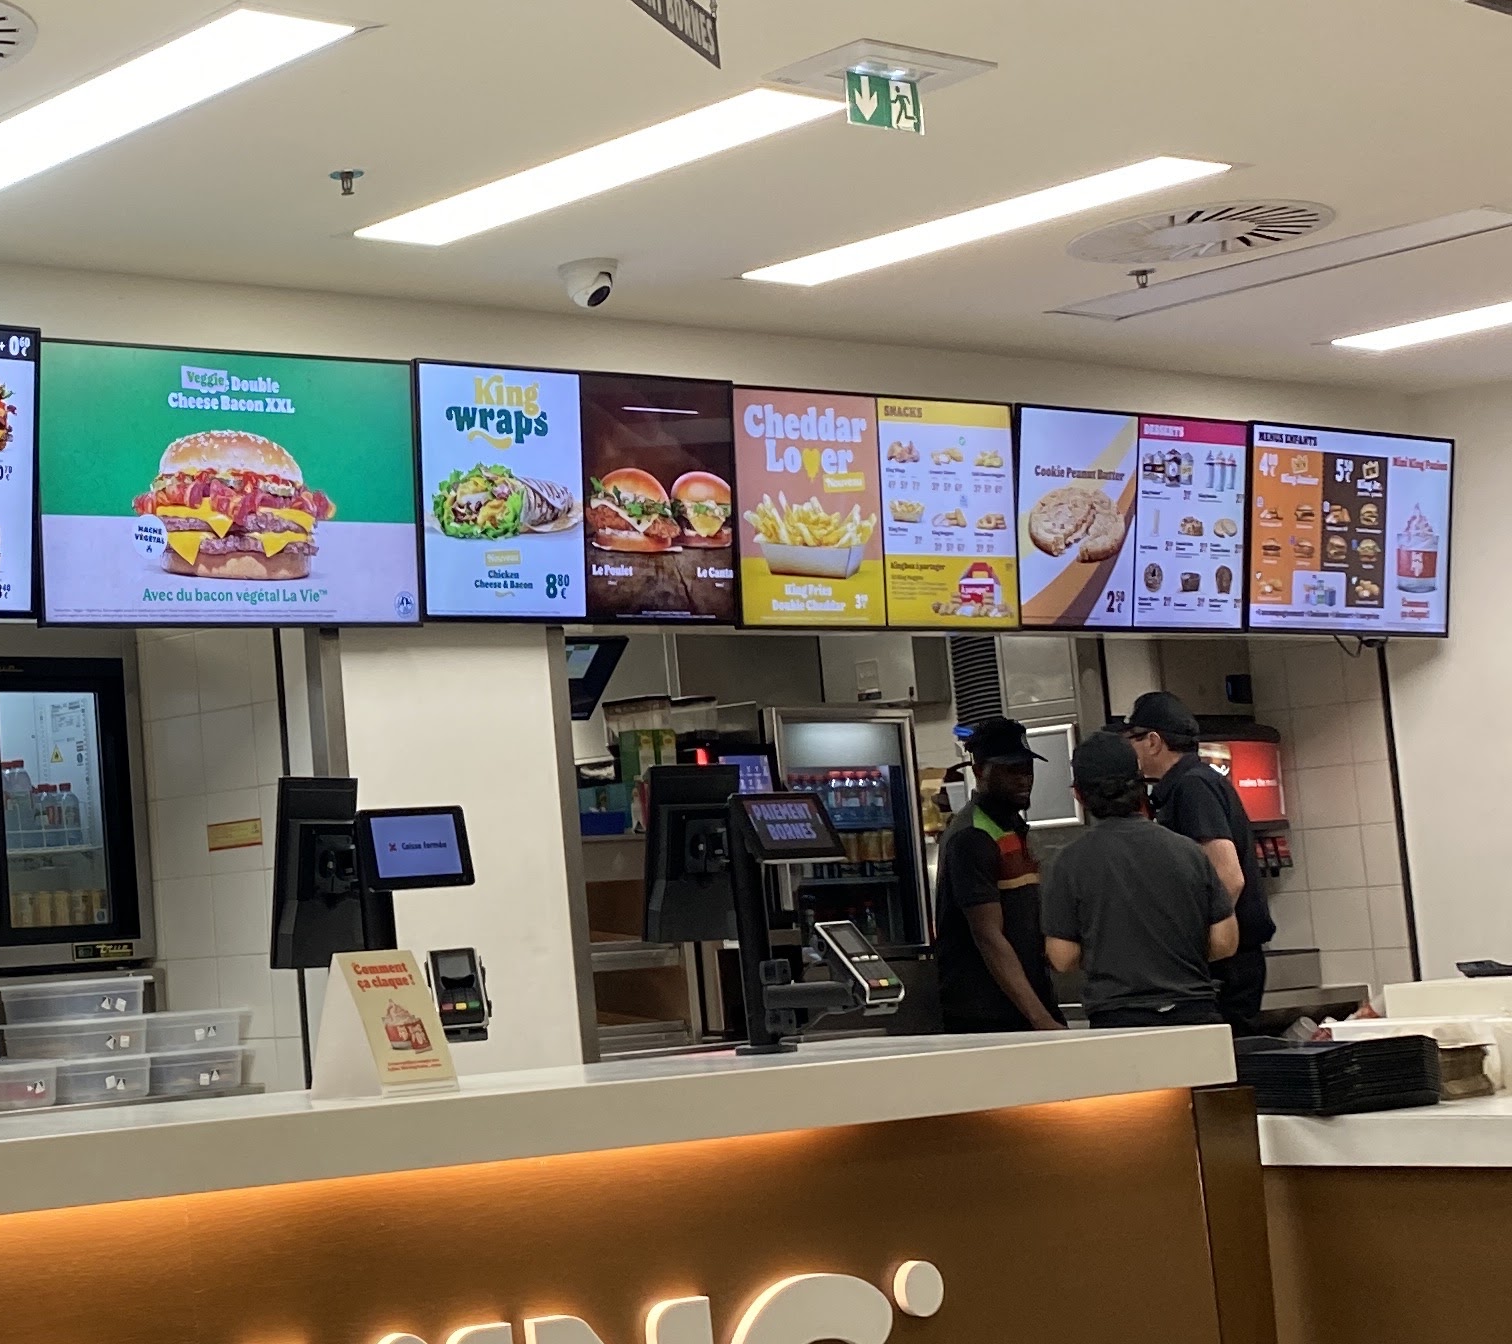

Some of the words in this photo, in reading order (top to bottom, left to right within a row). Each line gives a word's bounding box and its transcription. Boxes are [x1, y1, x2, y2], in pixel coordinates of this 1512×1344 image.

[186, 370, 225, 388] Veggie
[230, 375, 280, 393] Double
[168, 392, 219, 410] Cheese
[220, 395, 265, 412] Bacon
[265, 397, 295, 413] XXL
[474, 374, 540, 417] King
[446, 405, 548, 444] wraps
[743, 404, 867, 443] Cheddar
[1034, 465, 1065, 478] Cookie
[1066, 467, 1096, 479] Peanut
[488, 569, 519, 579] Chicken
[474, 579, 502, 589] Cheese
[509, 580, 534, 589] Bacon
[143, 588, 173, 602] Avec
[176, 588, 192, 602] du
[195, 588, 233, 602] bacon
[236, 587, 280, 605] végétal
[282, 588, 297, 602] La
[751, 802, 812, 821] PAIEMENT
[351, 962, 408, 975] Comment
[357, 978, 371, 992] ça
